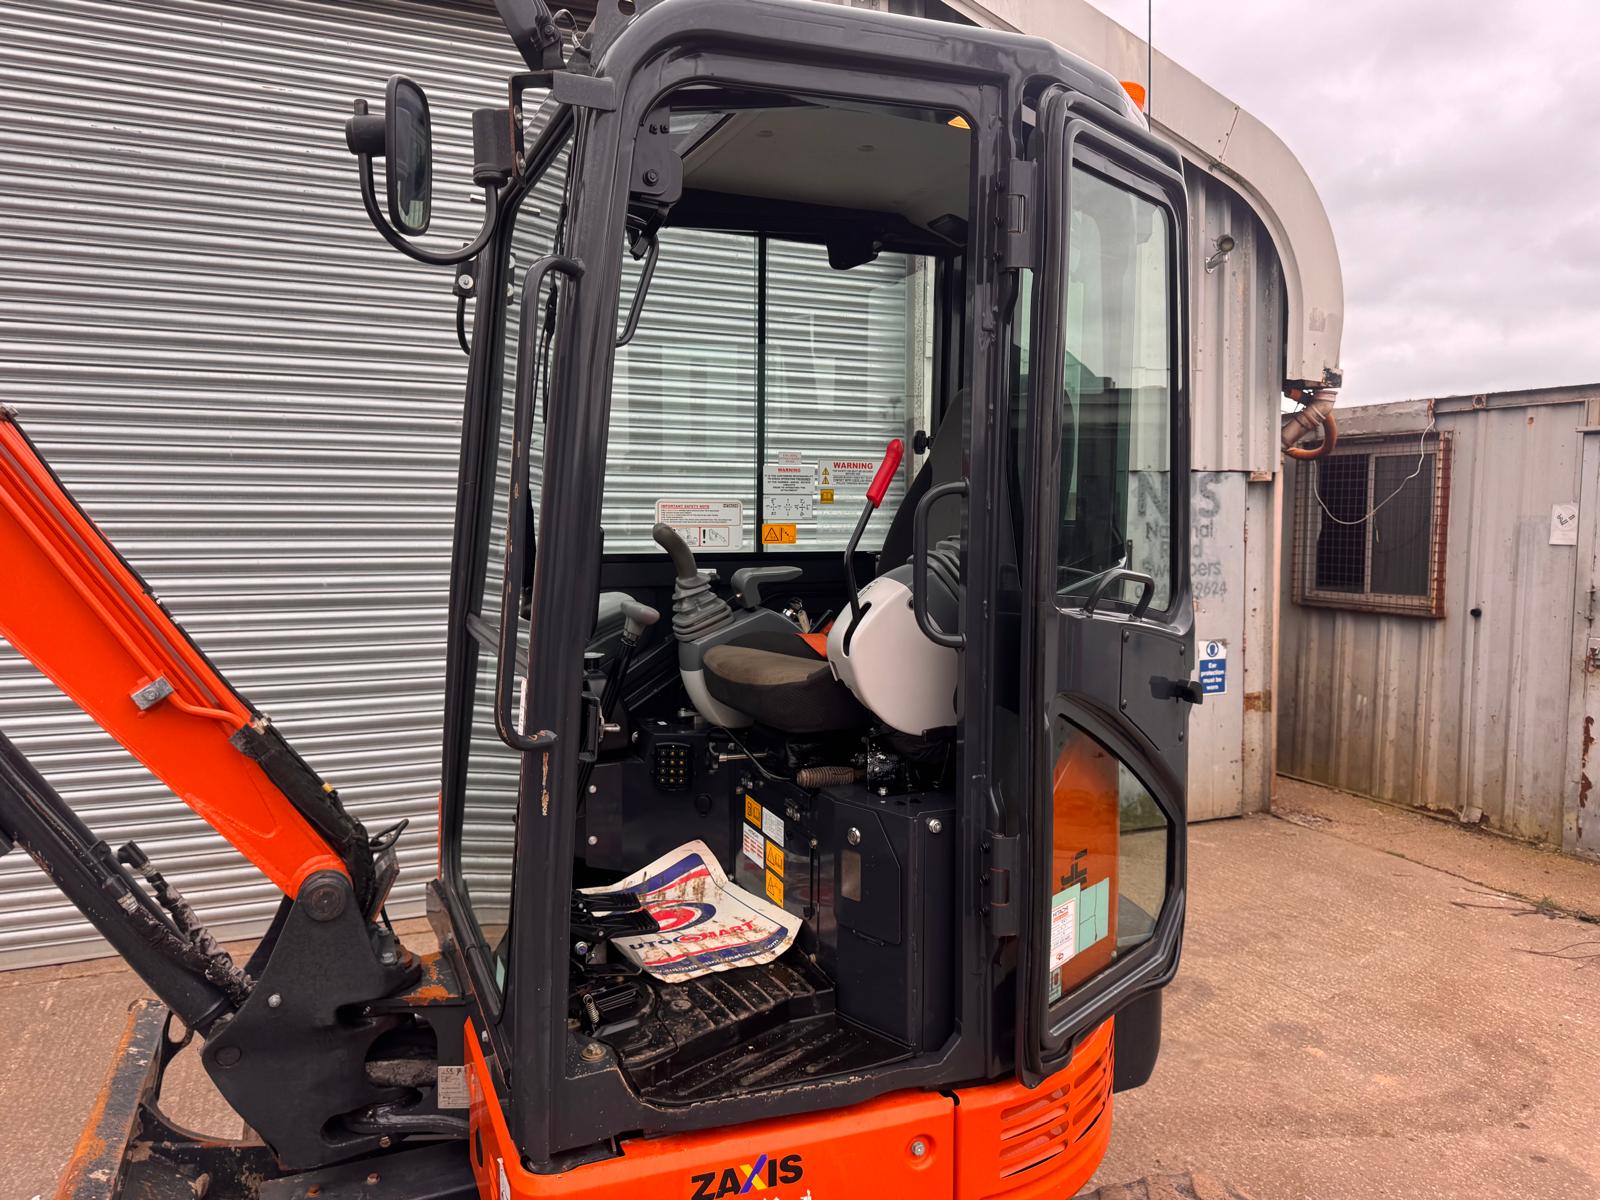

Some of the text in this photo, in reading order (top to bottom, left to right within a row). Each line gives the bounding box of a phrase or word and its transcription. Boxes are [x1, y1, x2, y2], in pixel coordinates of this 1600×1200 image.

[833, 461, 873, 470] WARNING
[1136, 473, 1222, 518] NS
[691, 1154, 803, 1200] ZAXIS
